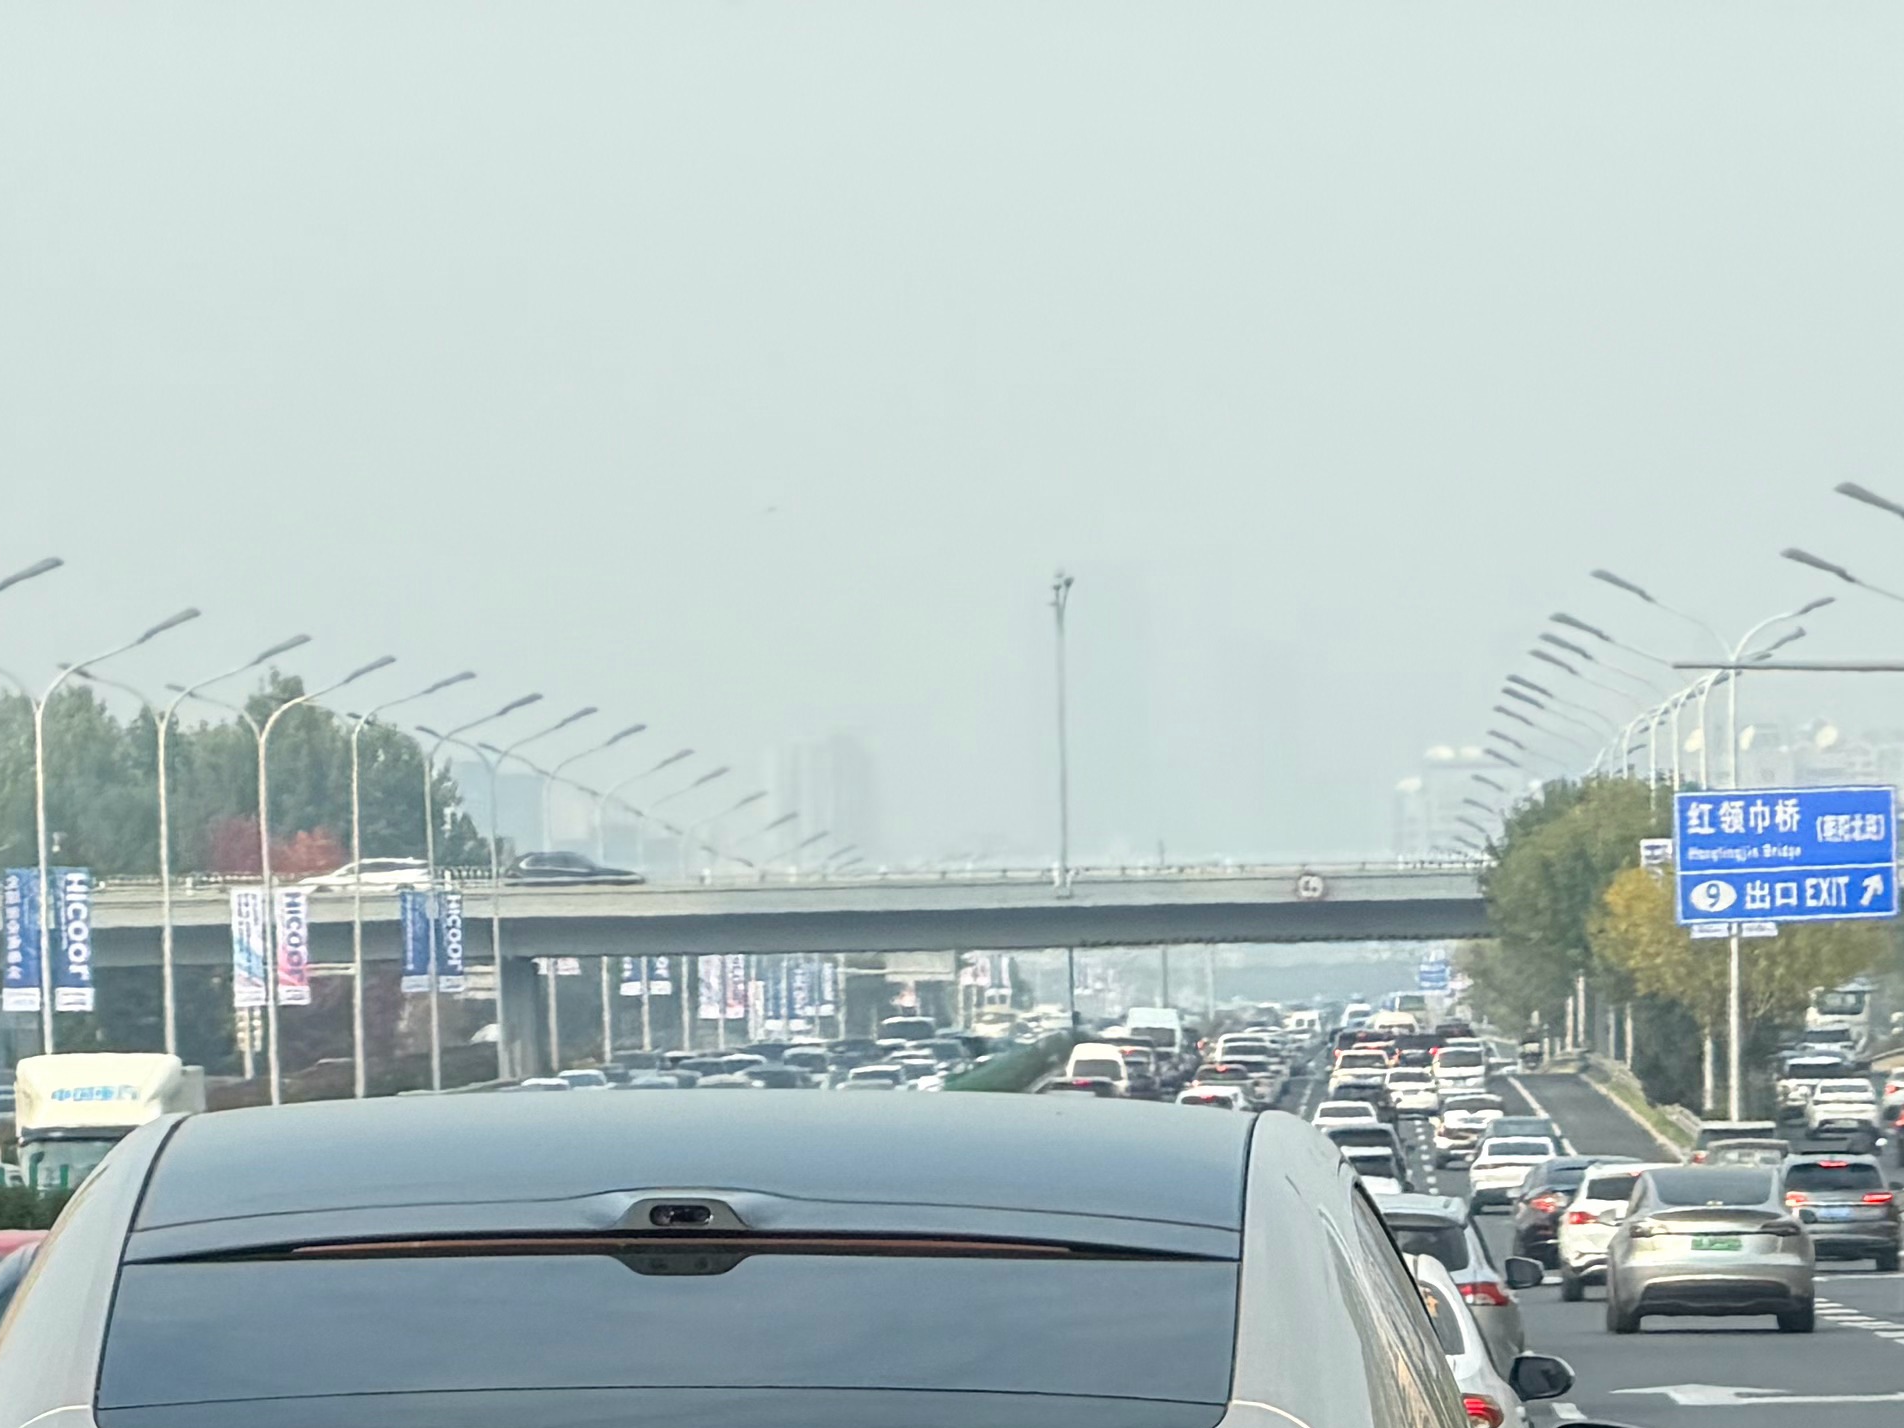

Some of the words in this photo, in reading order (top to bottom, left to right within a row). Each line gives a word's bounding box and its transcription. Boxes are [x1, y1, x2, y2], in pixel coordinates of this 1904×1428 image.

[1687, 799, 1801, 834] 红领巾桥
[1706, 883, 1721, 909] 9
[1745, 880, 1798, 909] 出口
[1805, 876, 1850, 907] EXIT
